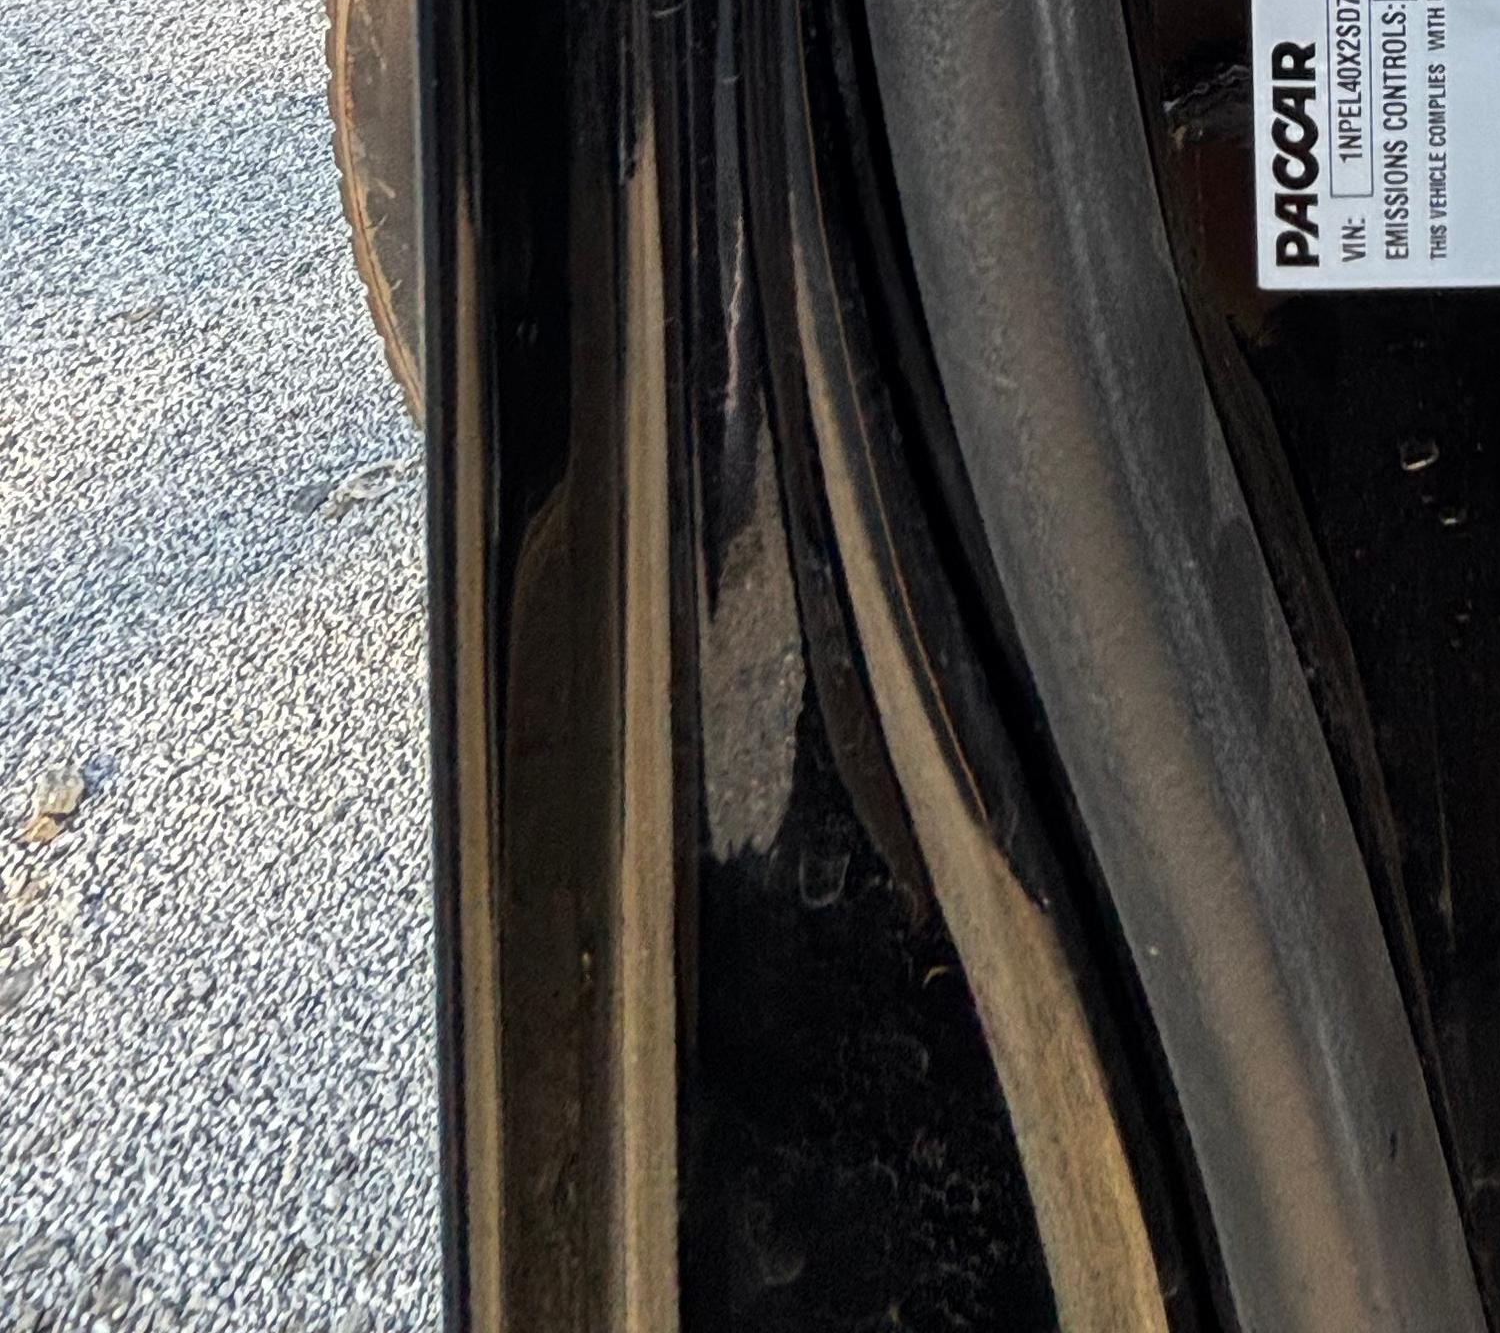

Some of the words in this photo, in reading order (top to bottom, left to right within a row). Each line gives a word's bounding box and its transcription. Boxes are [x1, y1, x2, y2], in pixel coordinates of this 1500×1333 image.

[1381, 2, 1408, 131] CONTROLS:
[1426, 6, 1446, 51] WITH
[1427, 62, 1447, 147] COMPLIES
[1270, 40, 1321, 267] PACCAR
[1427, 151, 1447, 219] VEHICLE
[1381, 138, 1409, 260] EMISSIONS
[1341, 216, 1367, 262] VIN:
[1428, 223, 1448, 260] THIS
